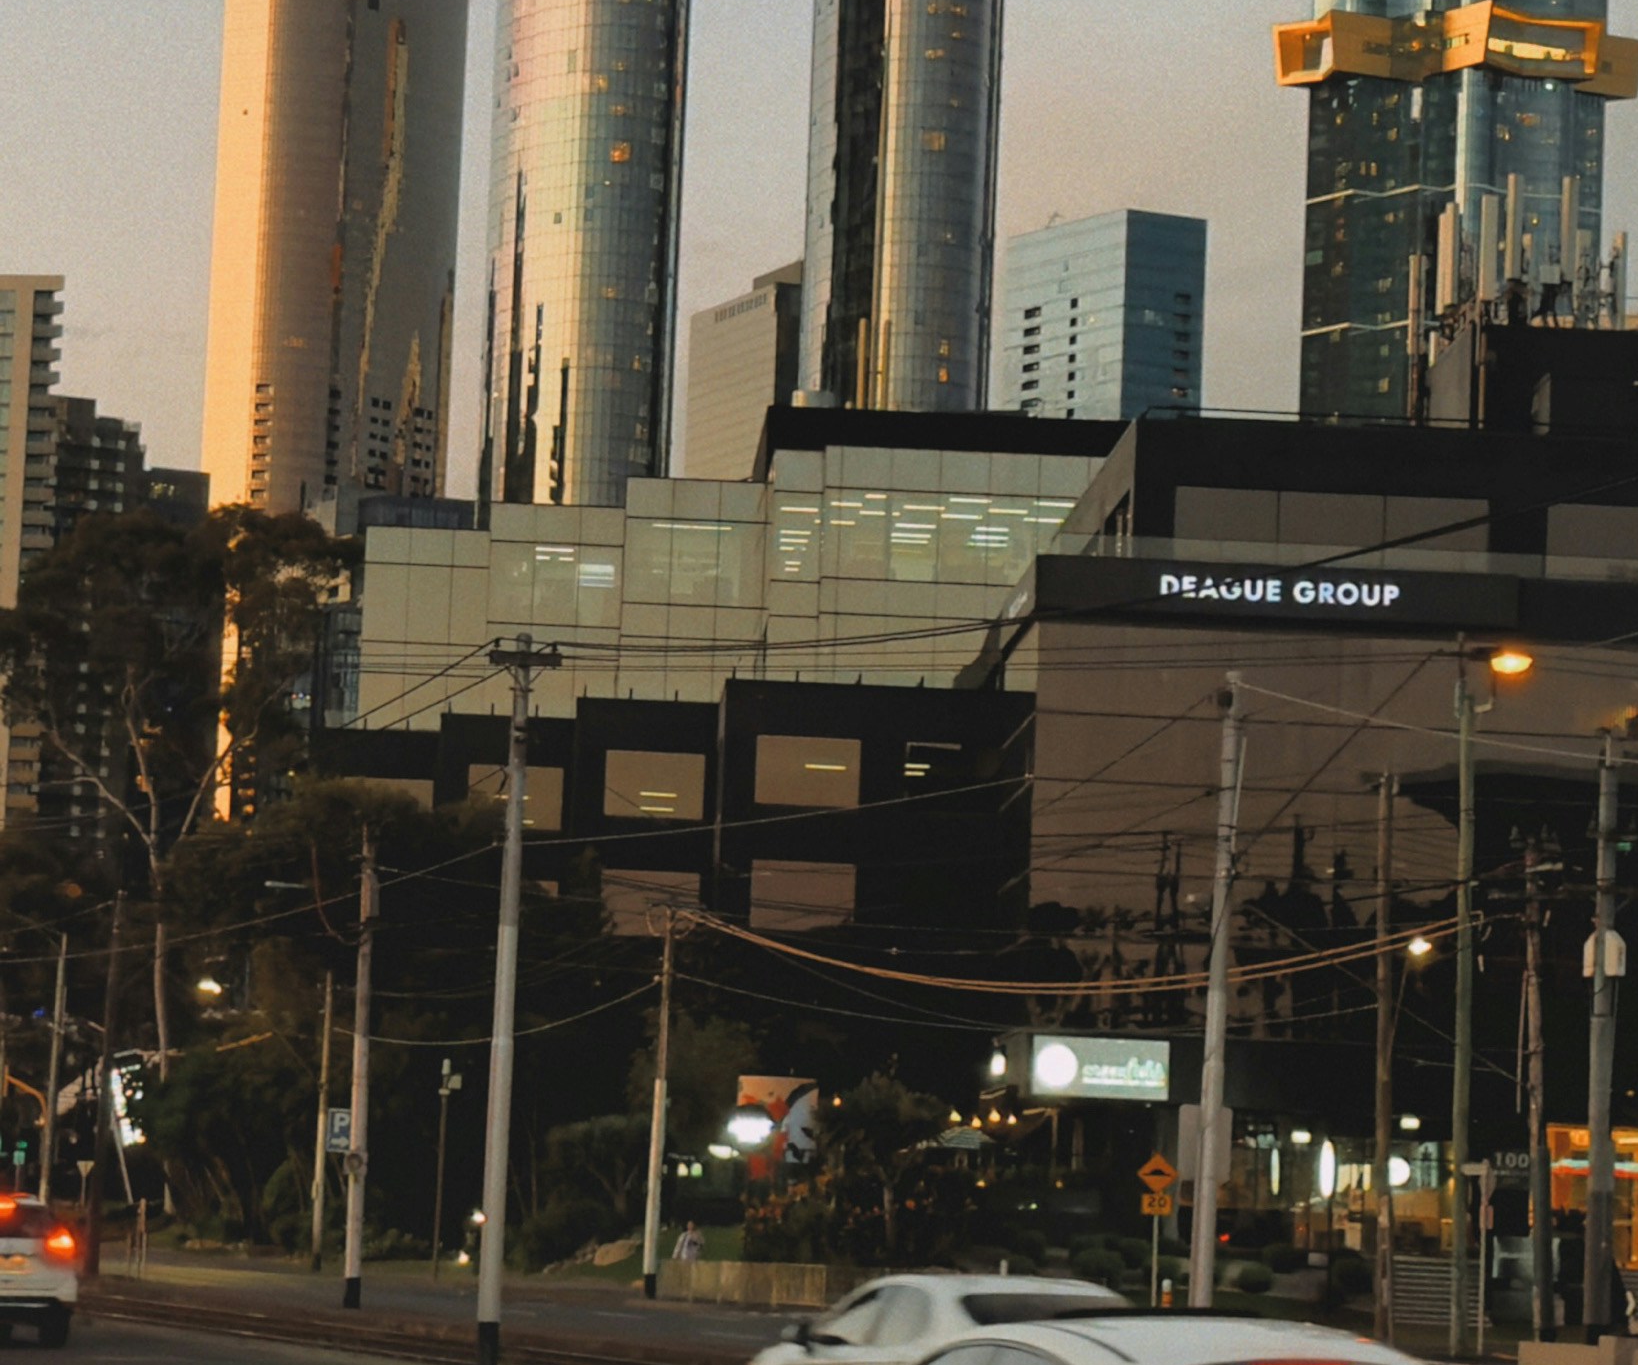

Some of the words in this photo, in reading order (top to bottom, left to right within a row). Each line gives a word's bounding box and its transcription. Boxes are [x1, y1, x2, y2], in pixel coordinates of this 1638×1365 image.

[1160, 573, 1282, 602] DEAGUE
[1292, 581, 1400, 606] GROUP
[333, 1112, 350, 1133] P
[1495, 1152, 1530, 1168] 100
[1149, 1196, 1168, 1208] 20
